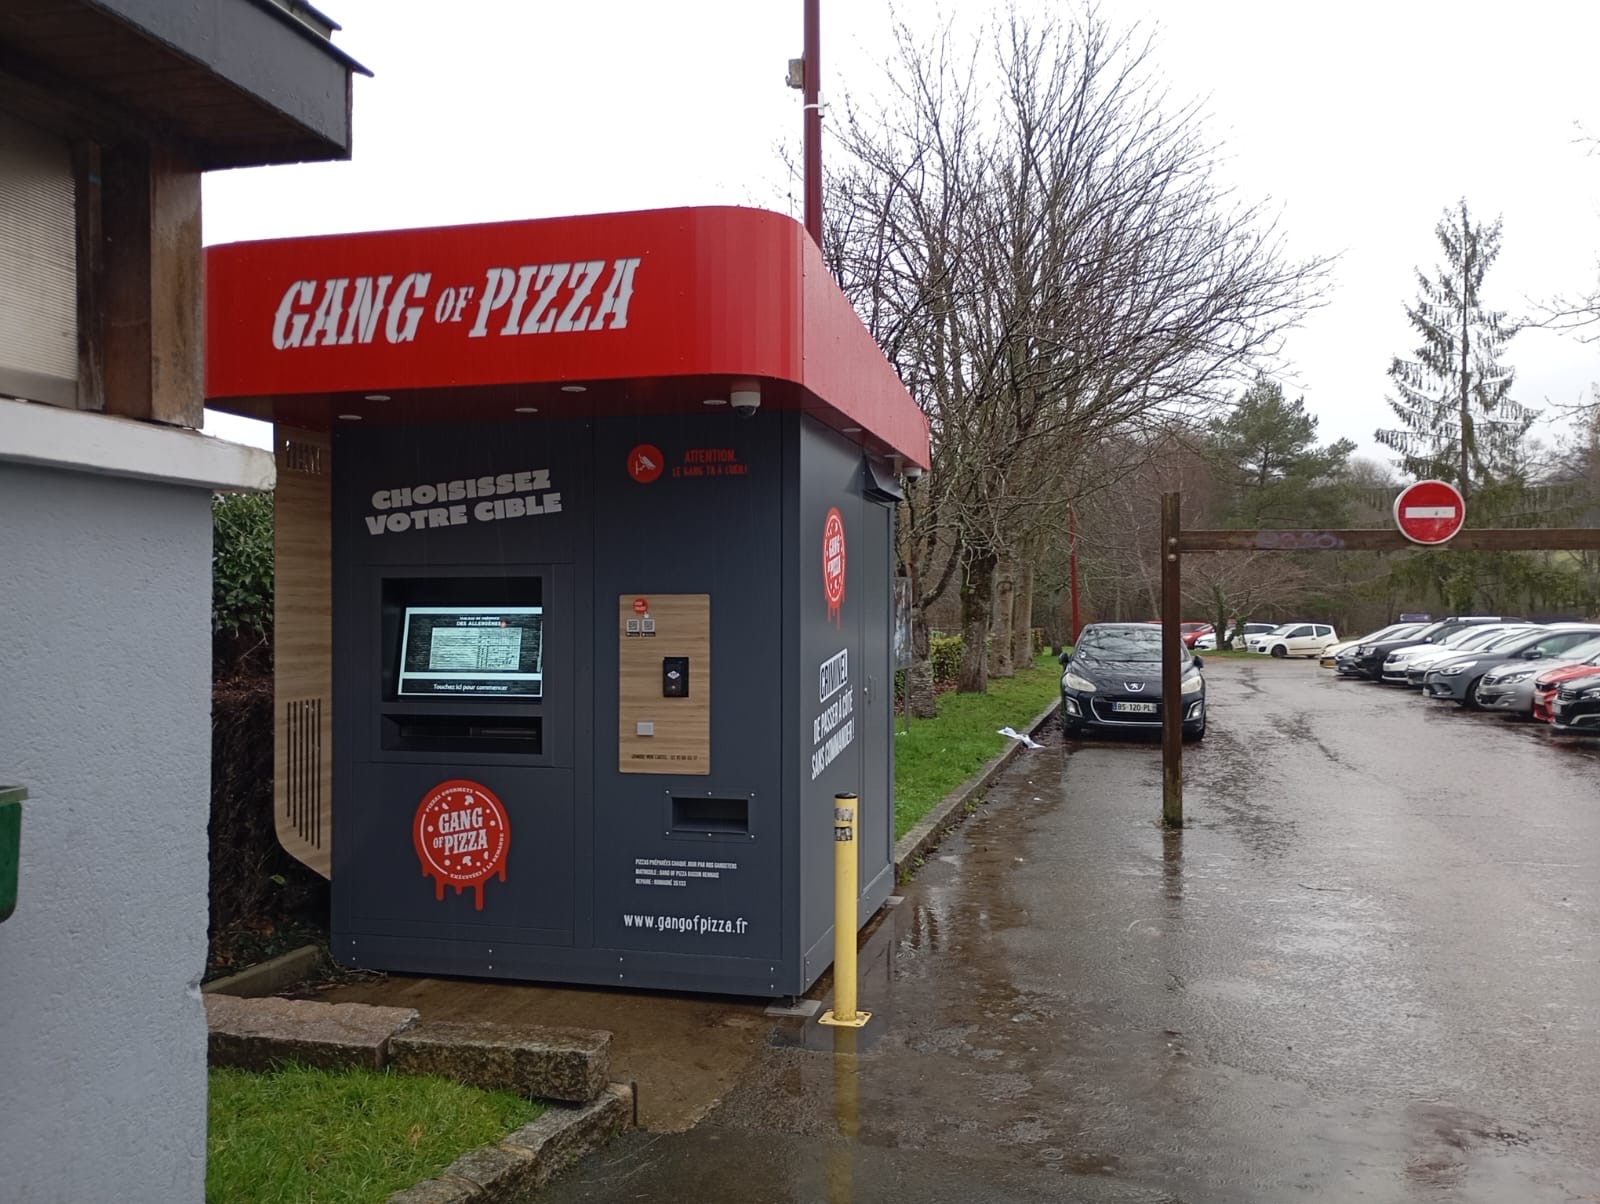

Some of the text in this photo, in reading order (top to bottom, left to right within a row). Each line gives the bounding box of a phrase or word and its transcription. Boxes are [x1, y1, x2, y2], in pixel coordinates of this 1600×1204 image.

[271, 257, 642, 351] GANG OF PIZZA
[371, 469, 551, 510] CHOISISSEZ
[365, 492, 562, 536] VOTRE CIBLE
[814, 716, 820, 744] DE
[821, 701, 838, 739] PASSER
[812, 745, 825, 780] SANS
[439, 807, 483, 834] GANG
[433, 829, 488, 855] OF PIZZA
[624, 914, 748, 934] www.gangofpizza.fr
